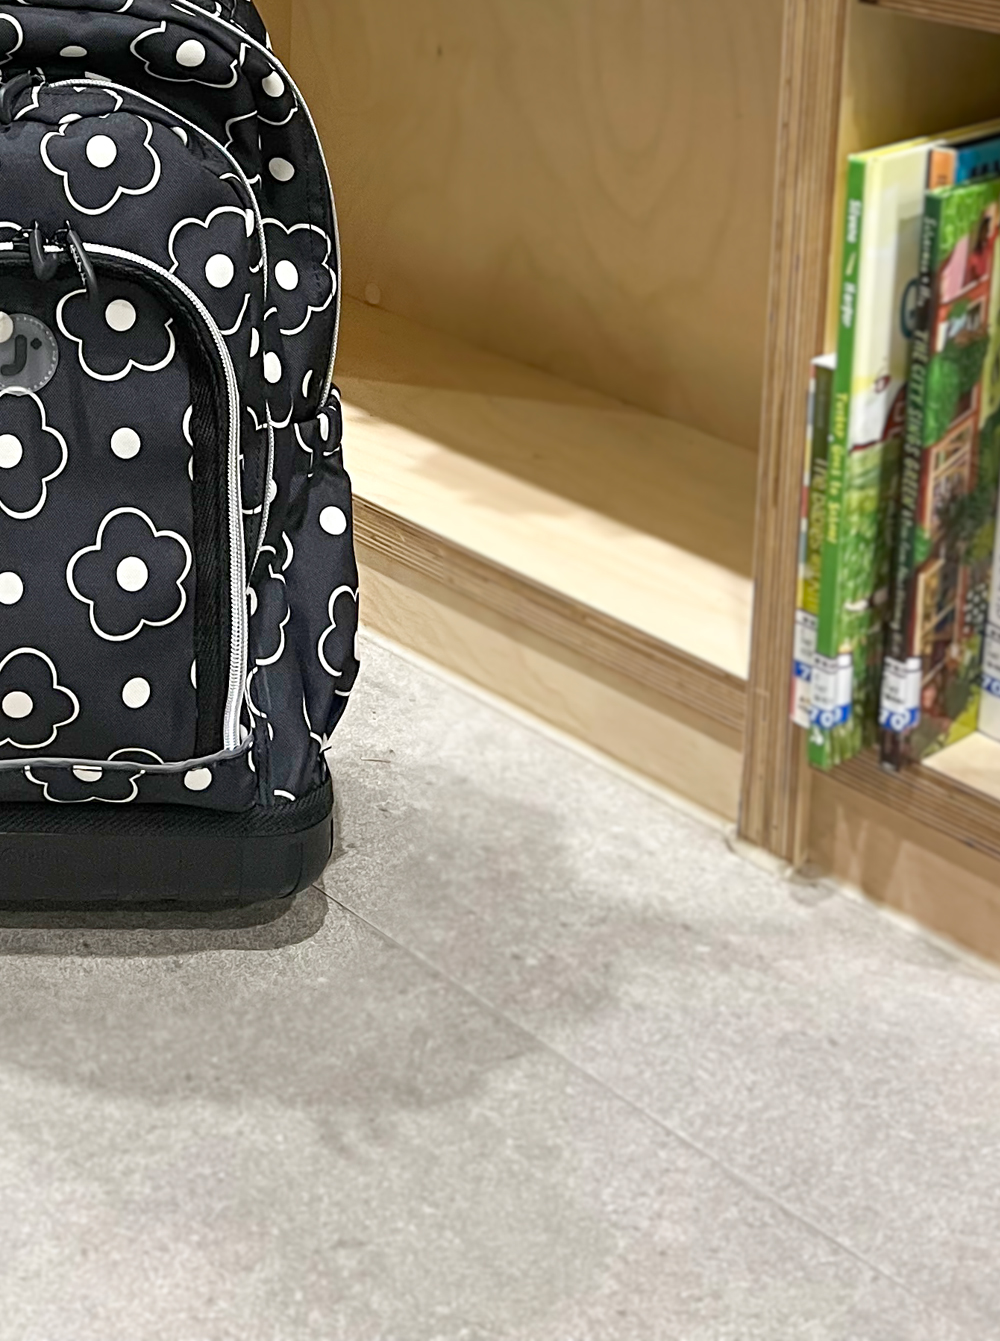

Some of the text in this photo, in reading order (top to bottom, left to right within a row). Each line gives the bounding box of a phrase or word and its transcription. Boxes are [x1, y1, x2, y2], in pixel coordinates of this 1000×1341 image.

[912, 329, 928, 363] THE
[909, 365, 927, 405] CITY
[904, 407, 923, 456] SINGS
[899, 457, 920, 510] GREEN
